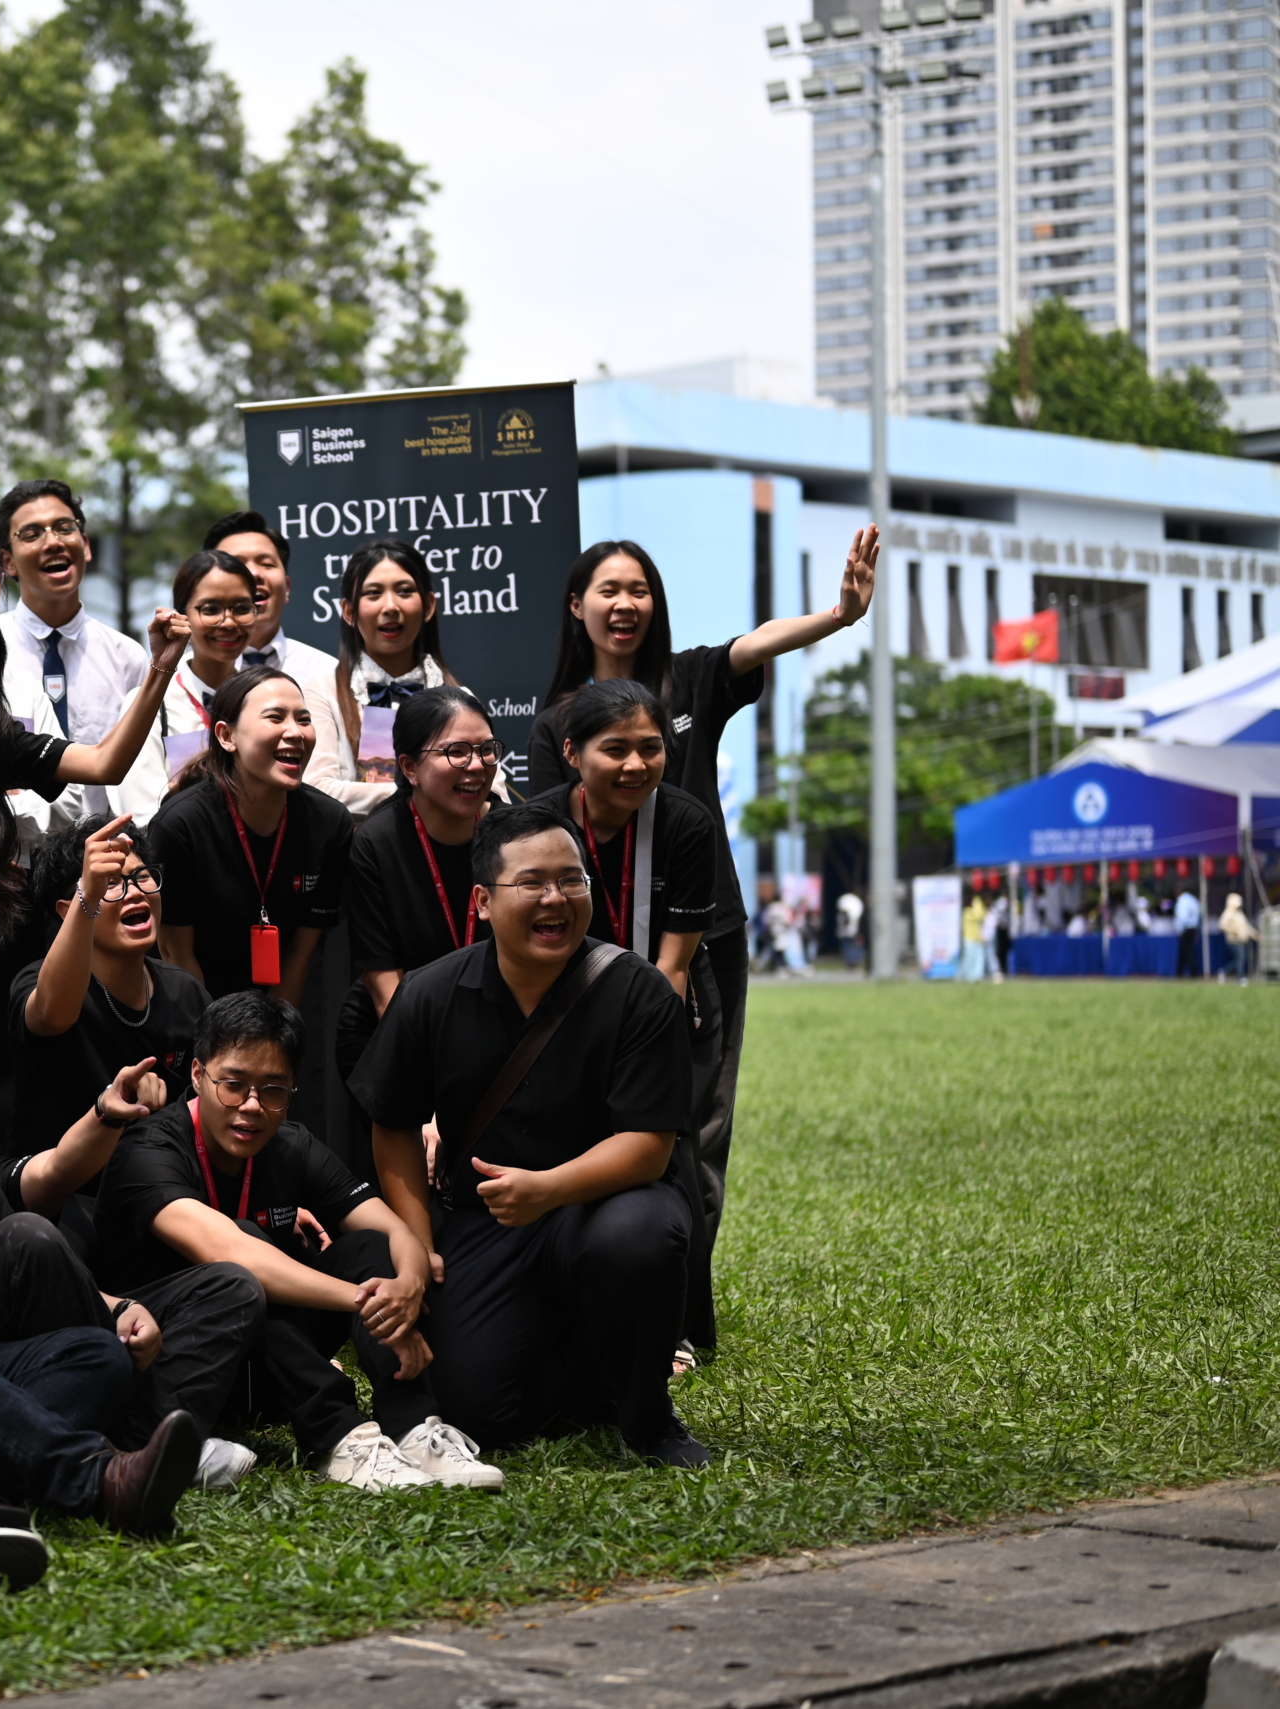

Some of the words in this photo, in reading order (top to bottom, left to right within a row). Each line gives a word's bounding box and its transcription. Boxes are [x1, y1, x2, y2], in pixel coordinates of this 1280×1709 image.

[312, 427, 353, 441] Saigon
[312, 439, 366, 452] Business
[313, 451, 354, 465] School
[278, 488, 548, 539] HOSPITALITY
[324, 535, 460, 579] trfer
[471, 543, 502, 570] to
[488, 696, 536, 717] School
[273, 1206, 292, 1214] Saigon
[275, 1217, 292, 1226] School
